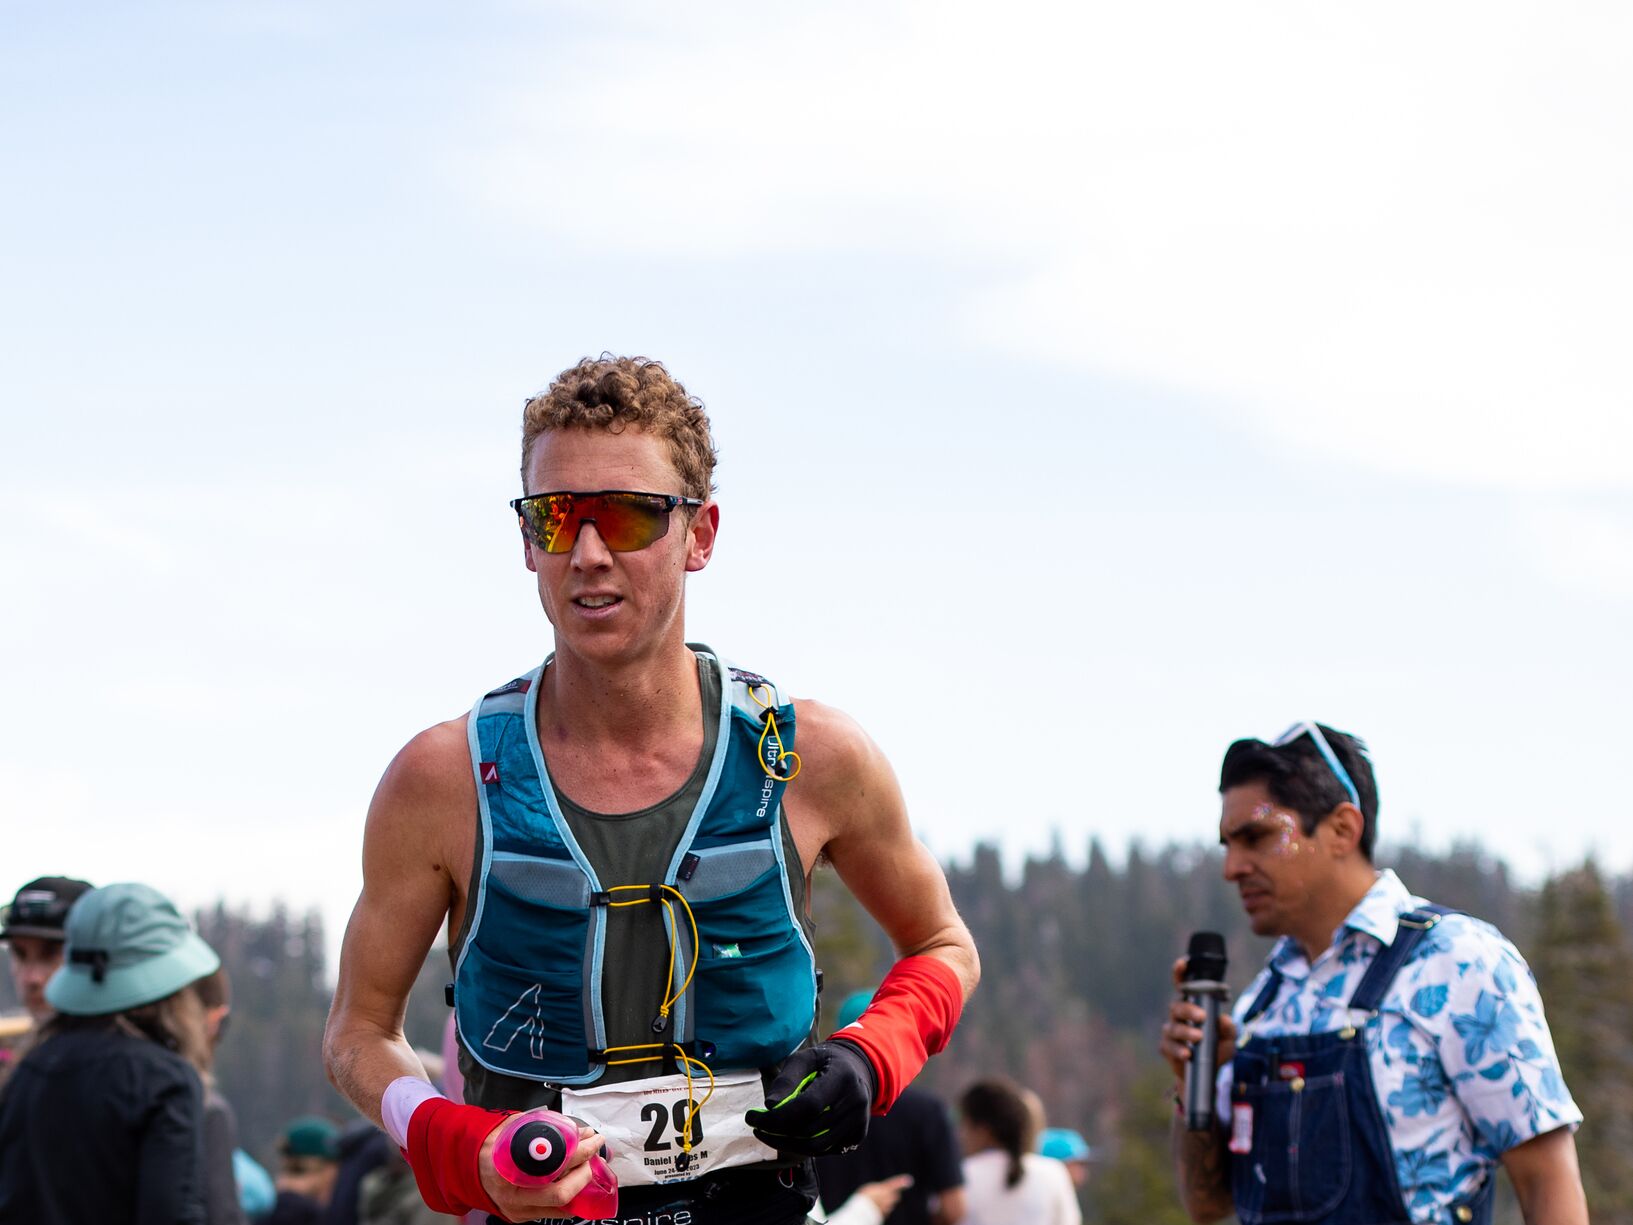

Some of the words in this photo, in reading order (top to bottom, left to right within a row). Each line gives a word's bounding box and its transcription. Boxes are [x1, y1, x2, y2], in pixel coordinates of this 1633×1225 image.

[640, 1098, 704, 1152] 29
[644, 1156, 671, 1166] Daniel
[700, 1150, 708, 1159] M
